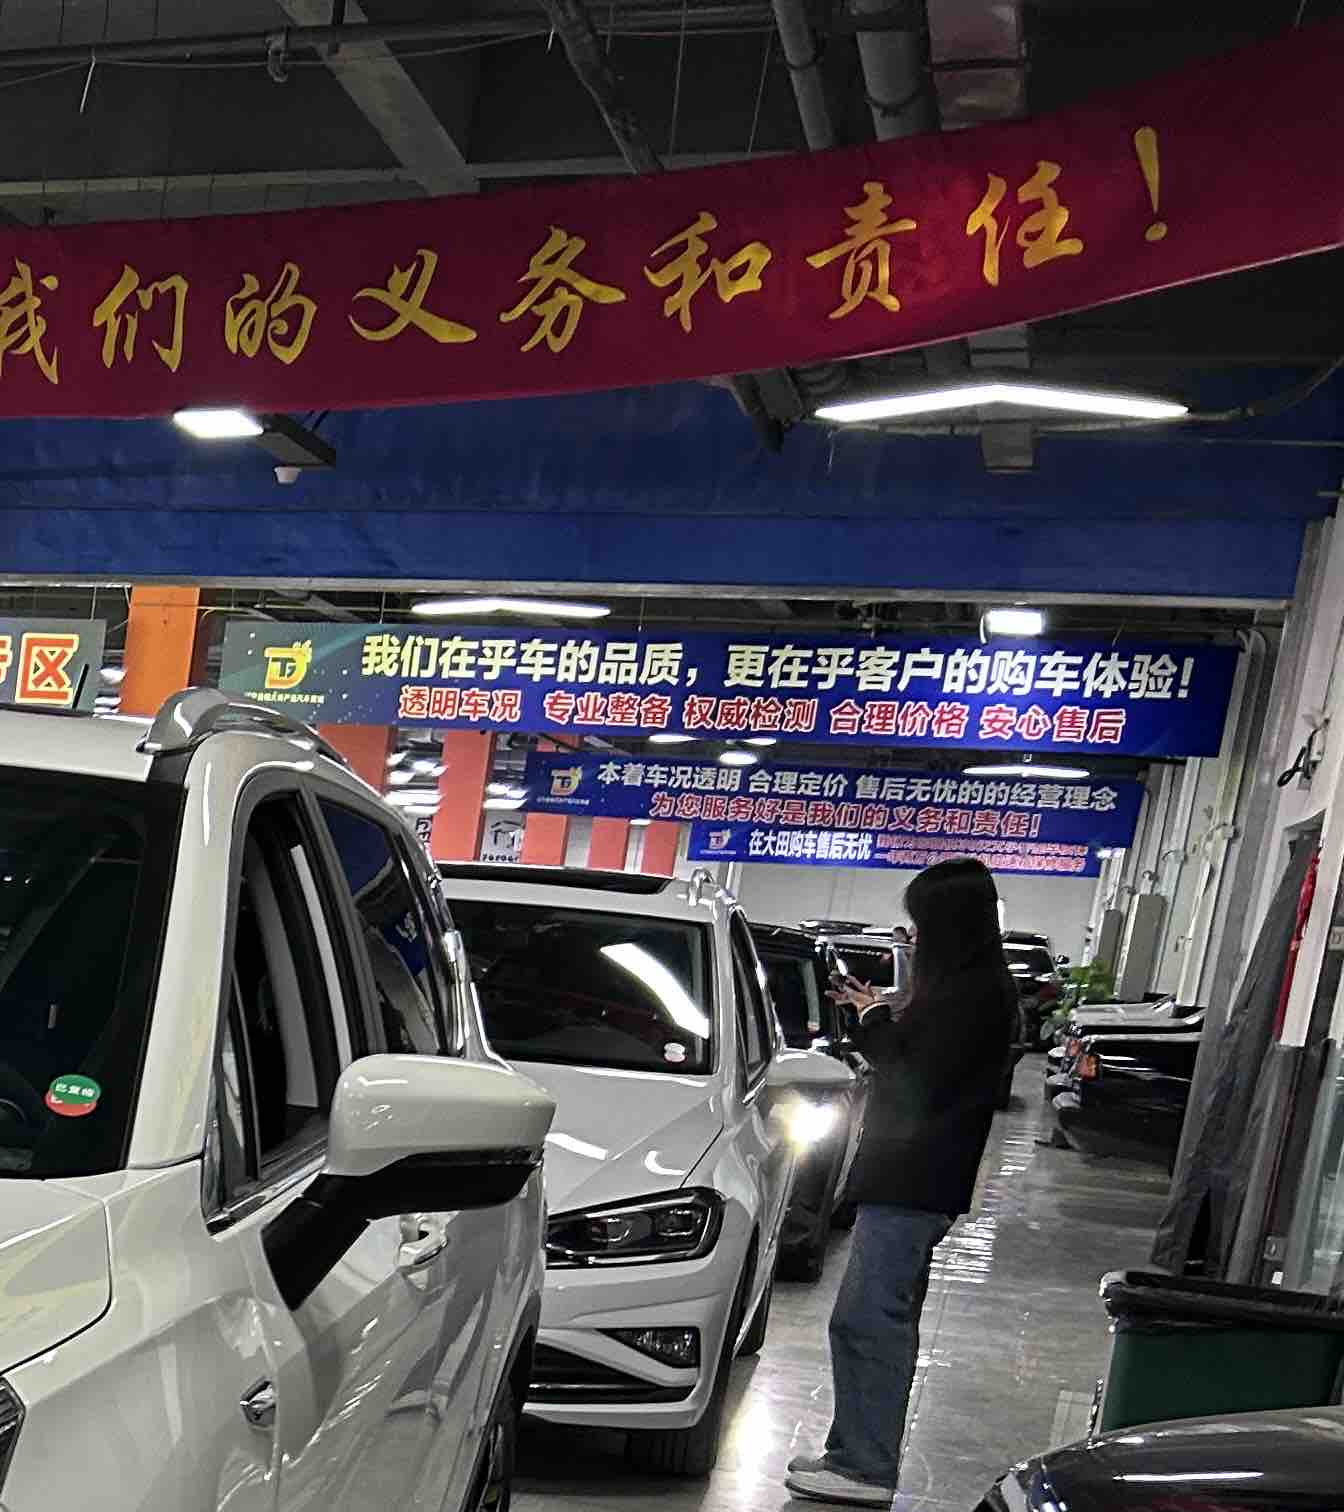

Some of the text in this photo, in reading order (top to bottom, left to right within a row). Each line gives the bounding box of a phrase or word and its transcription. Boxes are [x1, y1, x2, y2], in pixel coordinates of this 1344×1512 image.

[399, 685, 1126, 744] 透明车况 专业整备 权威检测 合理价格 安心售后
[597, 761, 1118, 811] 本着车况透明 合理定价 售后无忧的的经营理念
[649, 791, 1041, 839] 为您服务好是我们的义务和责任！
[748, 829, 872, 860] 在大田购车售后无忧
